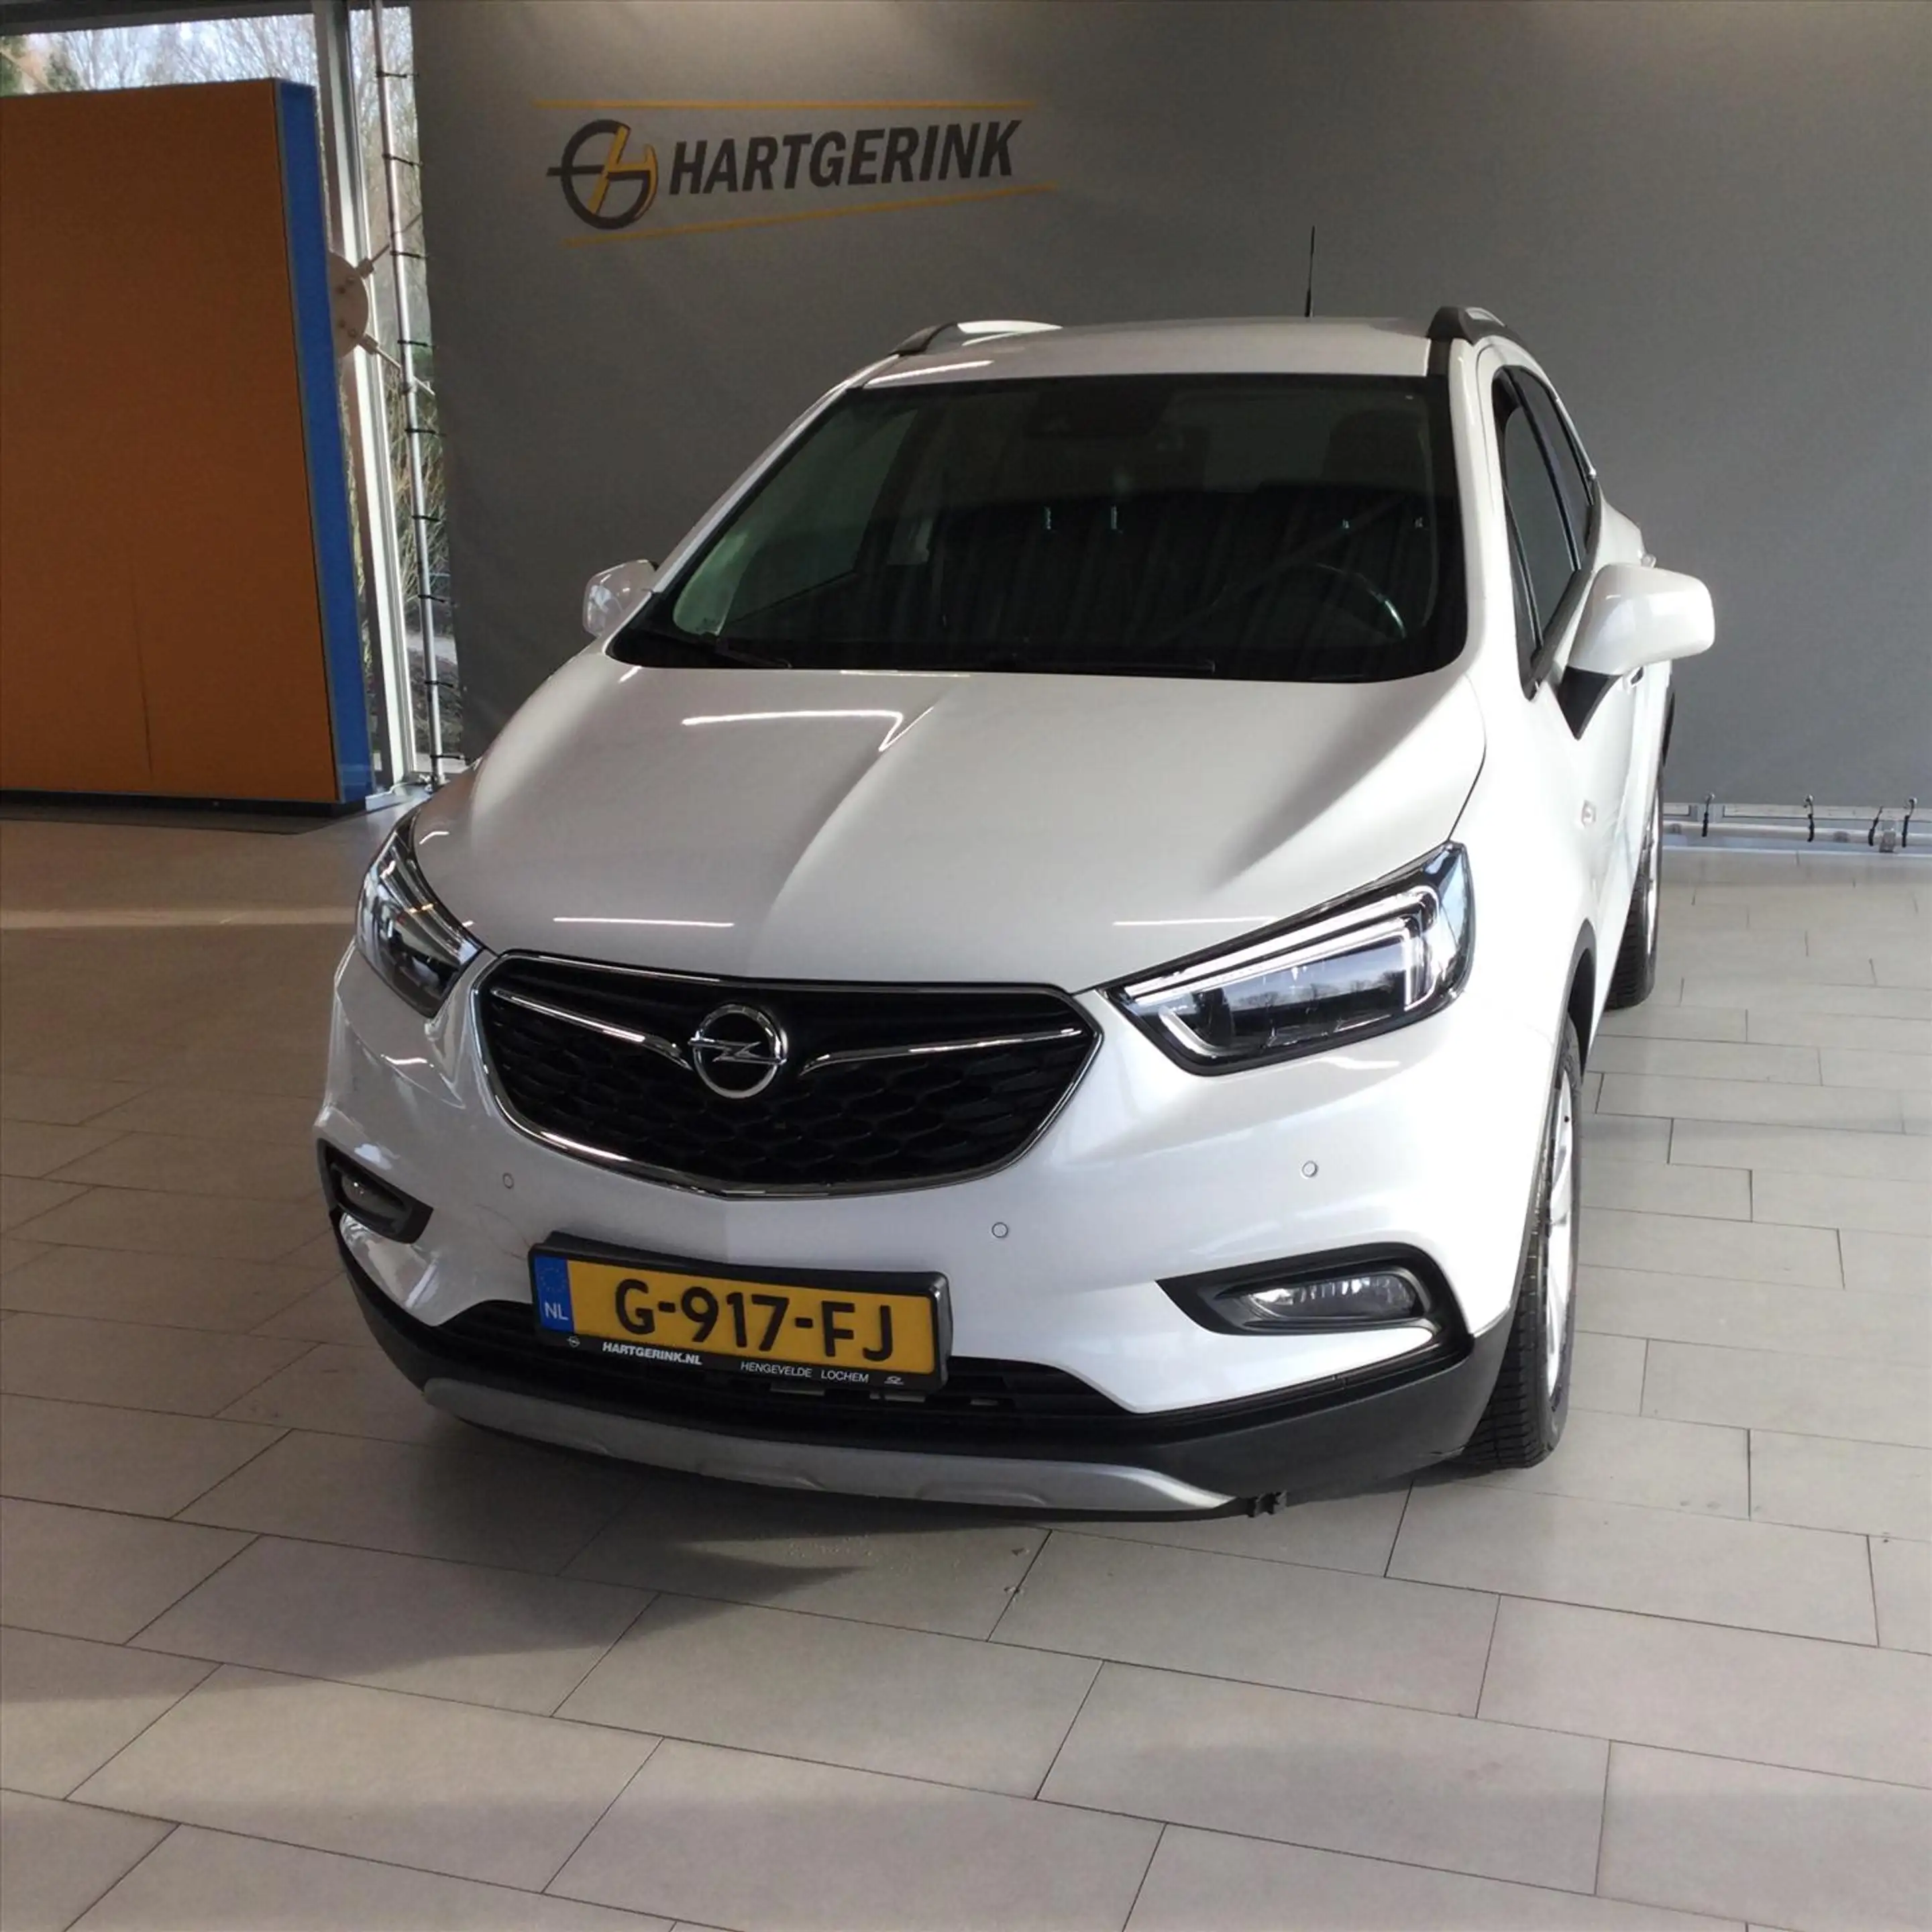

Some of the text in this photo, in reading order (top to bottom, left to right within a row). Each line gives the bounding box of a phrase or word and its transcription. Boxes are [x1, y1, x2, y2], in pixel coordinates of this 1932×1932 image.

[669, 119, 1022, 195] HARTGERINK
[544, 1301, 569, 1321] NL
[614, 1279, 893, 1361] G-917-FJ
[602, 1342, 702, 1365] HARTGERINK.NL
[741, 1361, 869, 1383] HENGEVELDE LOCHEM
